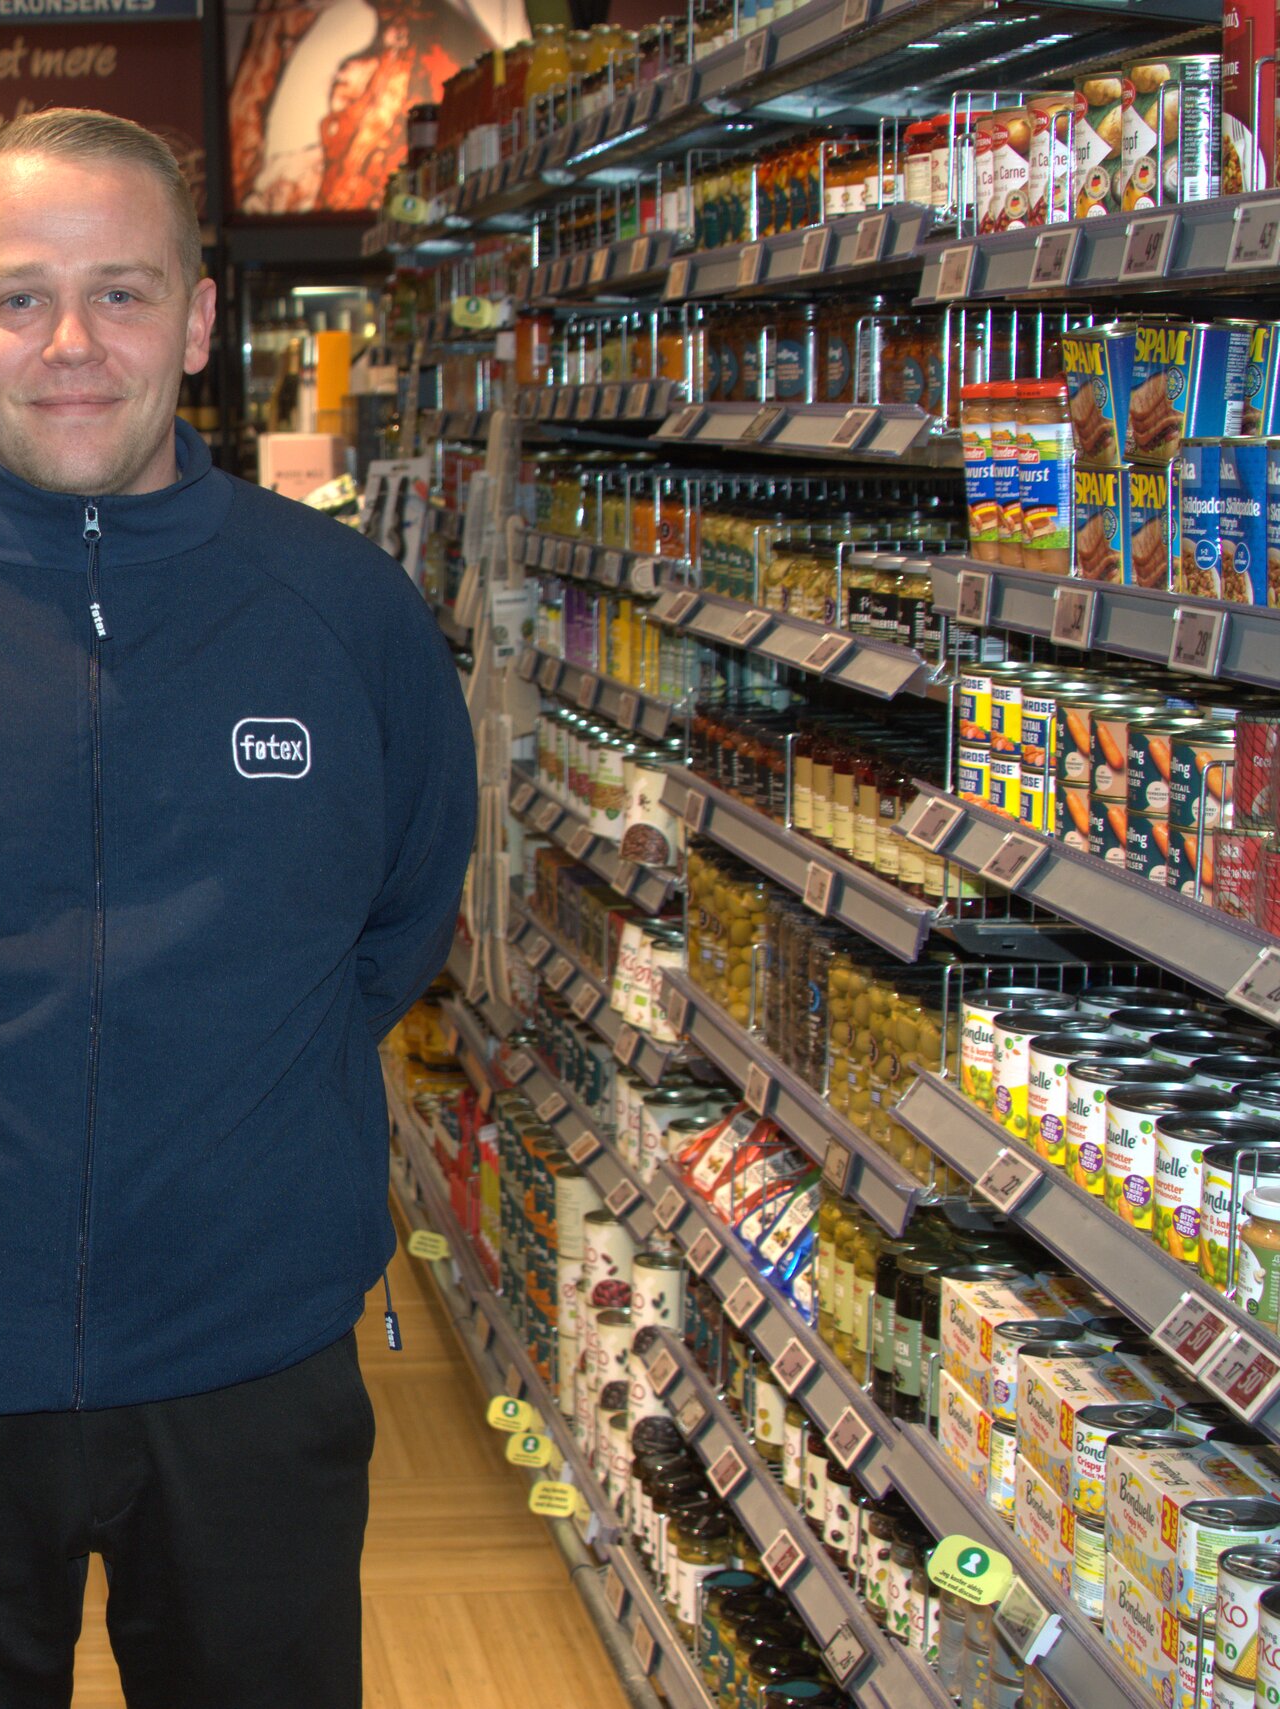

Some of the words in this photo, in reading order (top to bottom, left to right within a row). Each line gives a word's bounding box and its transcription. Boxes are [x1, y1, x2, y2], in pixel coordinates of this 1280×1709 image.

[30, 45, 118, 78] mere
[999, 165, 1026, 180] Carne
[1038, 153, 1068, 167] Cane
[1063, 339, 1105, 376] SPAM
[1134, 327, 1188, 365] SPAM
[1075, 472, 1116, 507] SPAM
[1131, 473, 1169, 510] SPAM
[88, 602, 109, 638] føtex
[239, 733, 306, 763] føtex
[1126, 1192, 1145, 1205] TASTE
[1129, 1181, 1144, 1192] BITE
[1176, 1224, 1196, 1237] TASTE
[1179, 1212, 1195, 1223] BITE
[1175, 1319, 1194, 1337] 17
[1187, 1324, 1213, 1351] 30
[1225, 1361, 1246, 1380] 17
[1237, 1365, 1264, 1395] 30
[1026, 1378, 1057, 1430] Bonduelle
[1077, 1456, 1101, 1473] Crispy
[1025, 1479, 1056, 1530] Bonduelle
[1119, 1472, 1155, 1527] Bonduelle
[1060, 1508, 1070, 1545] 3
[1161, 1498, 1171, 1537] 3
[1170, 1505, 1178, 1549] PACK
[933, 1576, 948, 1586] mere
[947, 1582, 959, 1591] end
[939, 1570, 951, 1579] Jeg
[950, 1575, 967, 1586] koster
[1118, 1580, 1155, 1637] Bonduelle
[1161, 1608, 1172, 1650] 3
